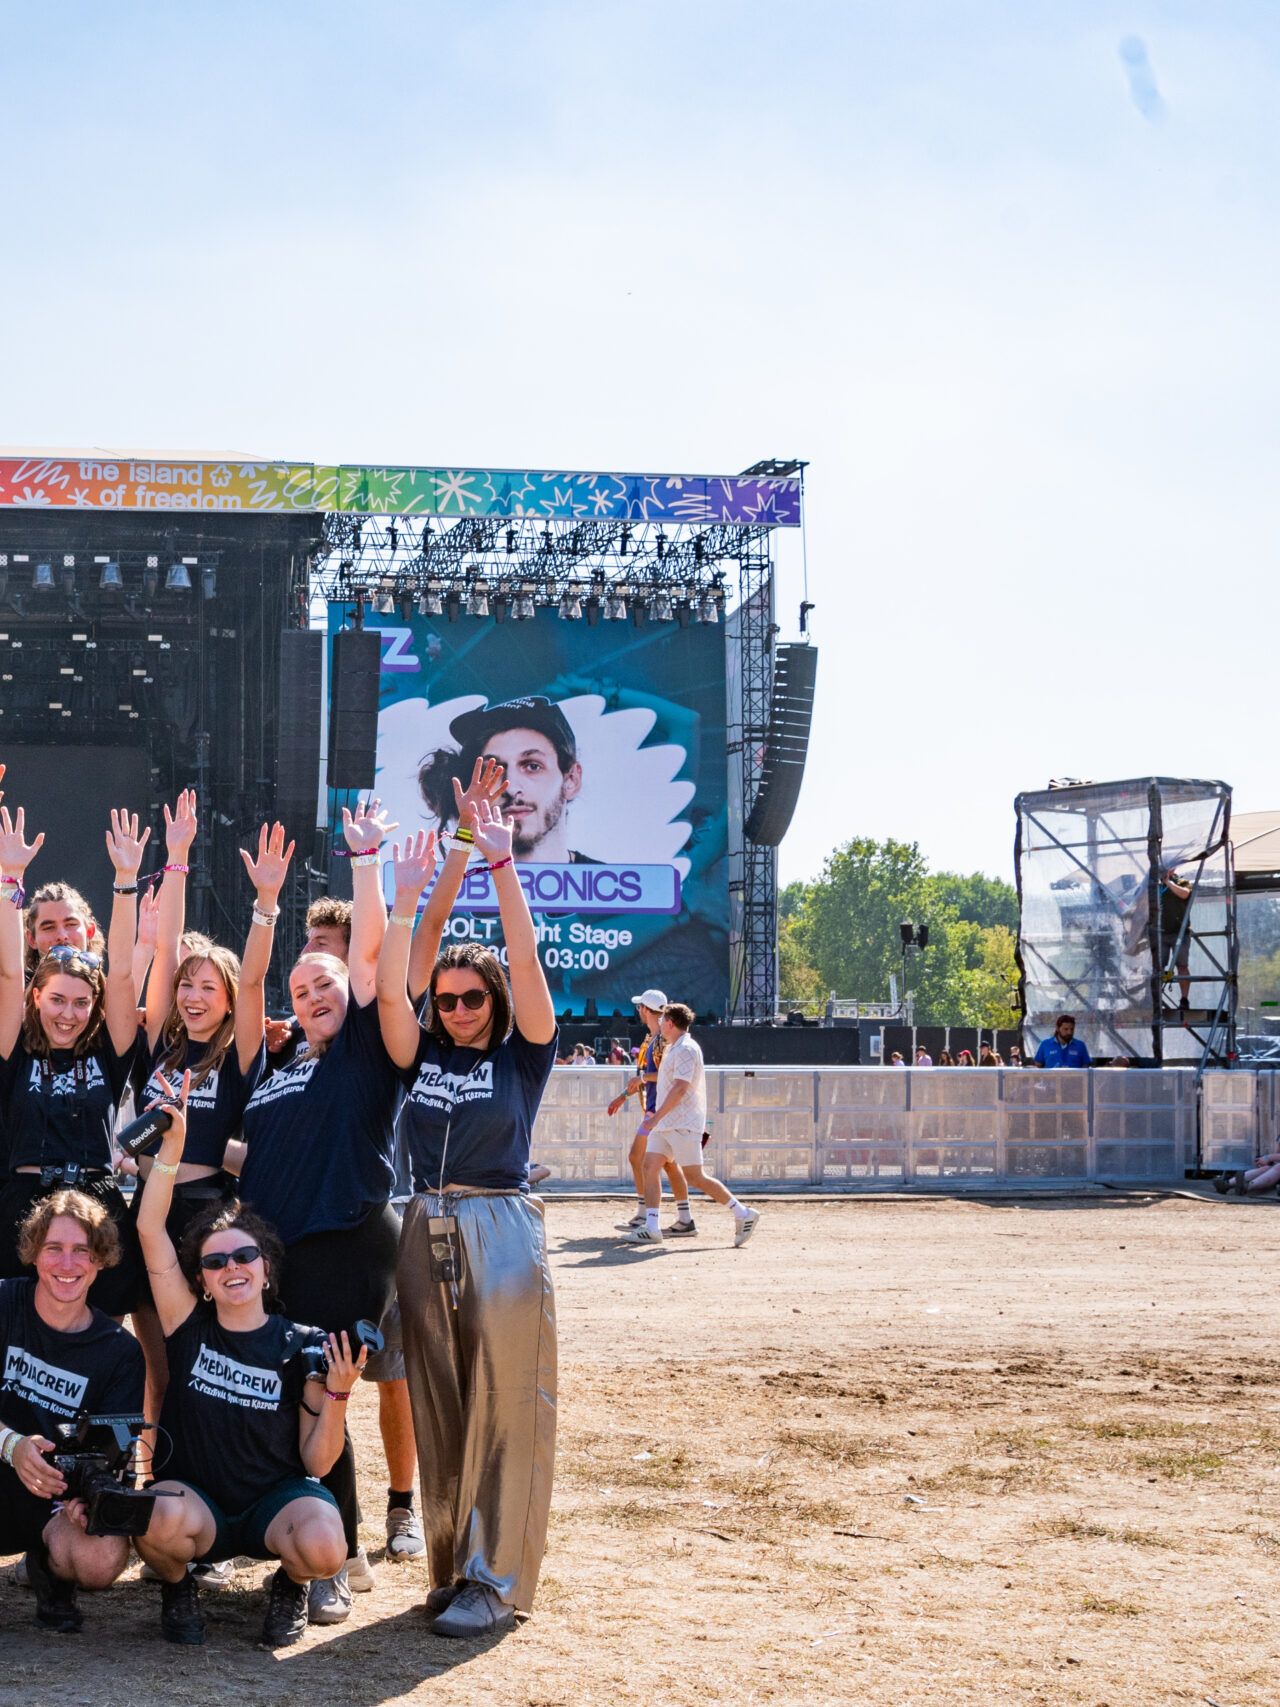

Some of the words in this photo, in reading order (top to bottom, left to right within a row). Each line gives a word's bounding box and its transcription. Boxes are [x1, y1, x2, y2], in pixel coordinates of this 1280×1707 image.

[78, 461, 119, 481] the
[129, 463, 203, 486] island
[100, 484, 127, 507] of
[135, 485, 242, 509] freedom
[568, 922, 633, 949] Stage
[544, 947, 610, 971] 03:00
[129, 1124, 157, 1148] Revolut
